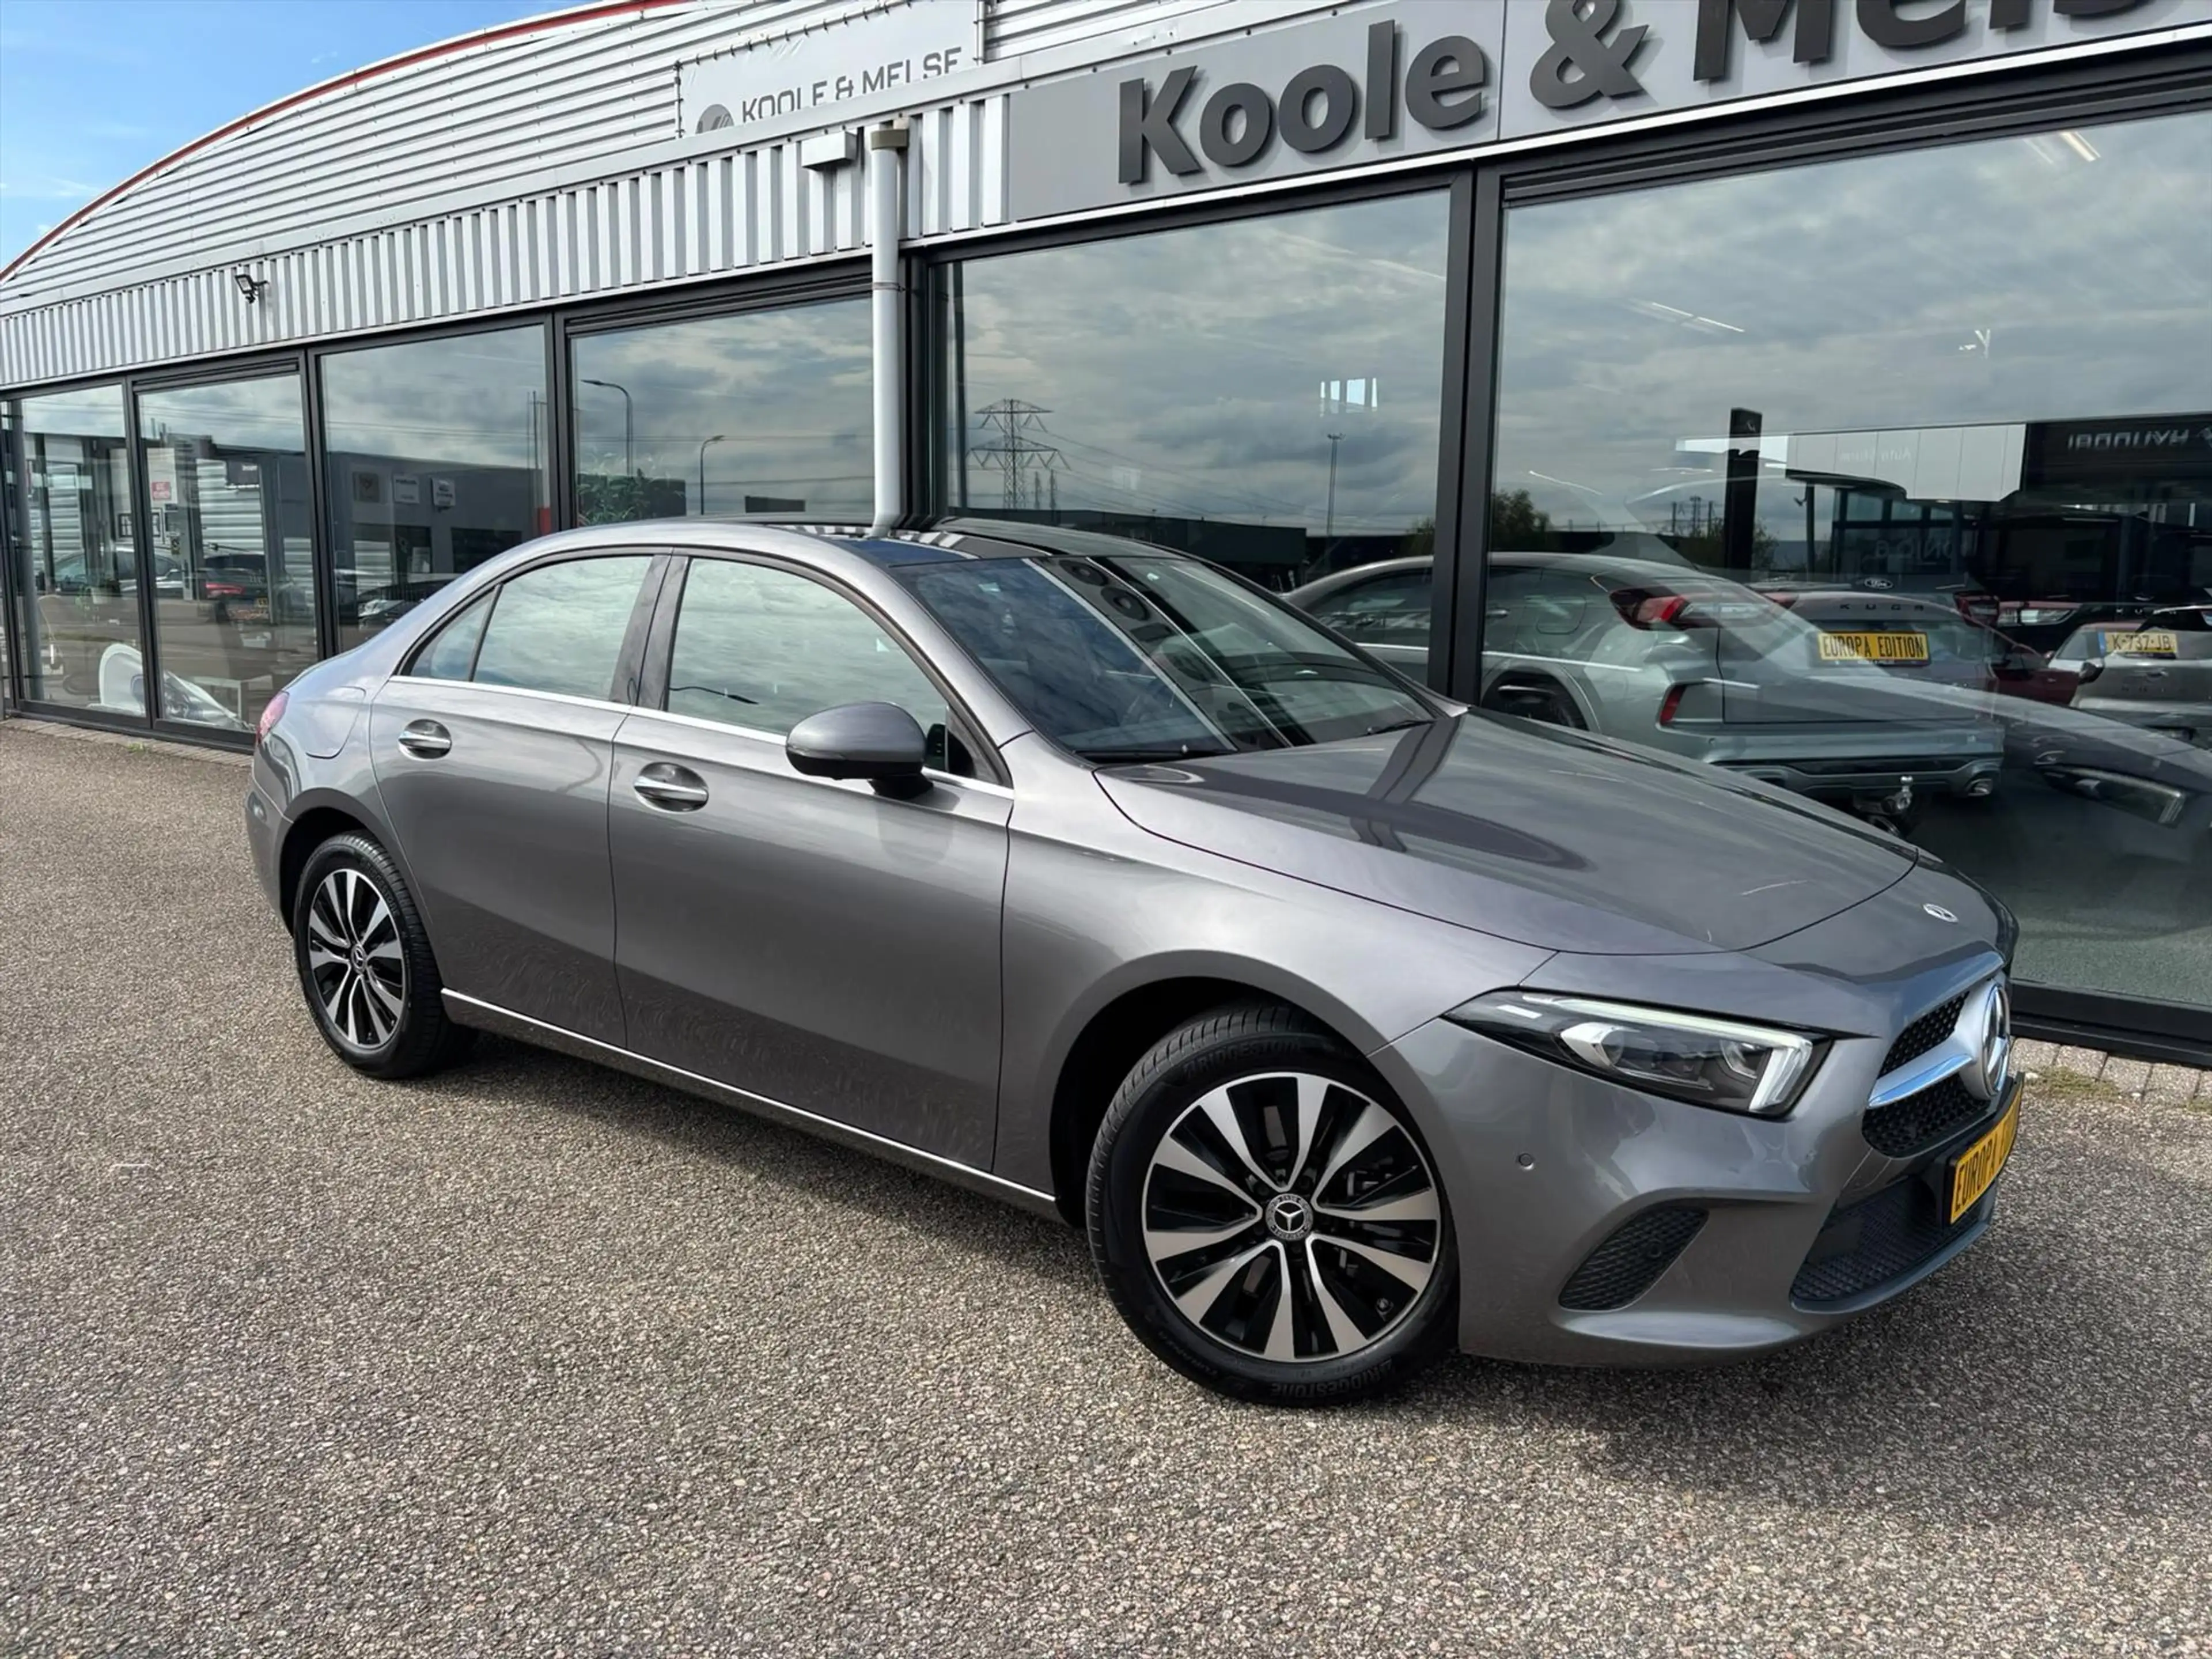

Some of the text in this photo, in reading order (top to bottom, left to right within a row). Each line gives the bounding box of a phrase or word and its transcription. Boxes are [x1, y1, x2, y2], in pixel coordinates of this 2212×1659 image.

[835, 75, 854, 101] &
[1118, 20, 1485, 184] Koole
[1530, 0, 1649, 108] &
[1822, 635, 1925, 657] EUROPA EDITION
